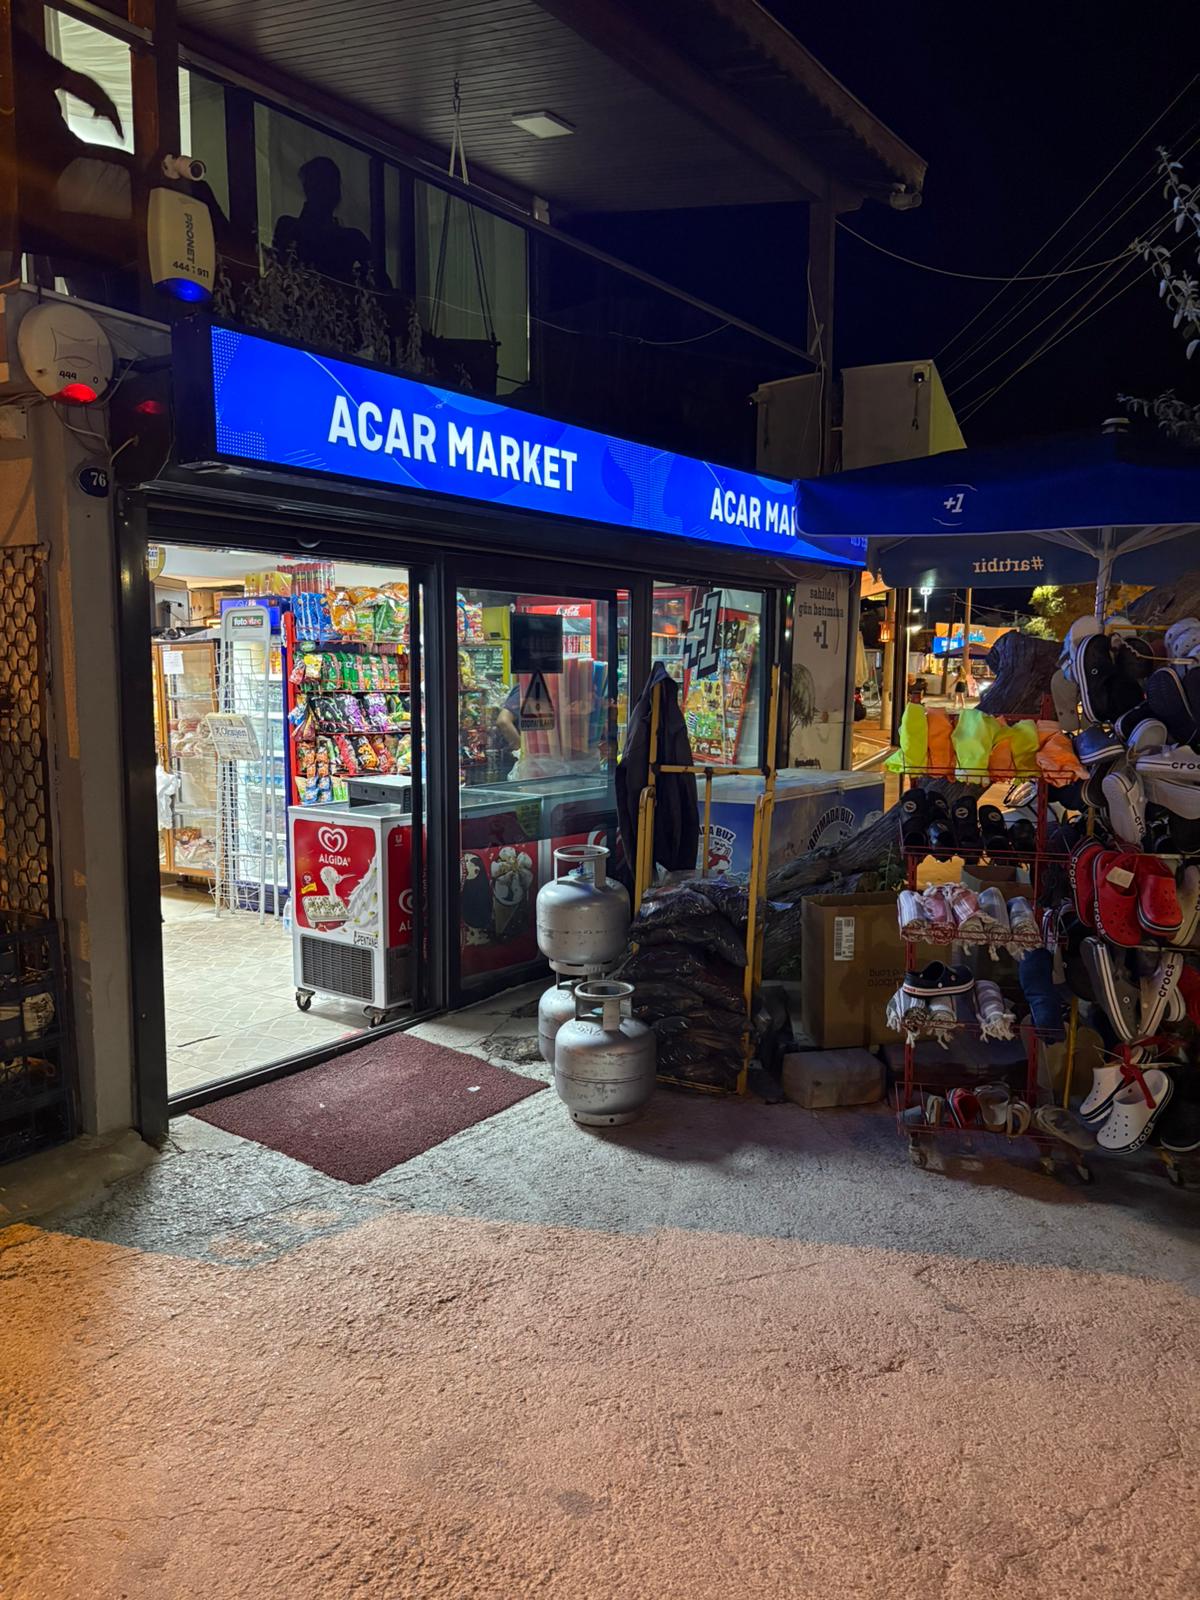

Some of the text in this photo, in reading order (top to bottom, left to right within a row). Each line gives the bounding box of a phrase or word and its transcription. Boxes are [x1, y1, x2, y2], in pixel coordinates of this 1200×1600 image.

[184, 212, 195, 265] PRONET
[172, 261, 190, 272] 444
[328, 394, 578, 493] ACAR MARKET
[90, 472, 107, 488] 76
[710, 487, 761, 531] ACAR
[943, 493, 966, 514] +1
[810, 587, 835, 602] sahilde
[798, 602, 813, 618] gün
[684, 589, 722, 681] +1
[813, 620, 828, 649] +1
[716, 827, 735, 843] BUZ
[1069, 856, 1077, 889] crocs
[1158, 963, 1176, 998] crocs
[1129, 1120, 1155, 1151] crocs
